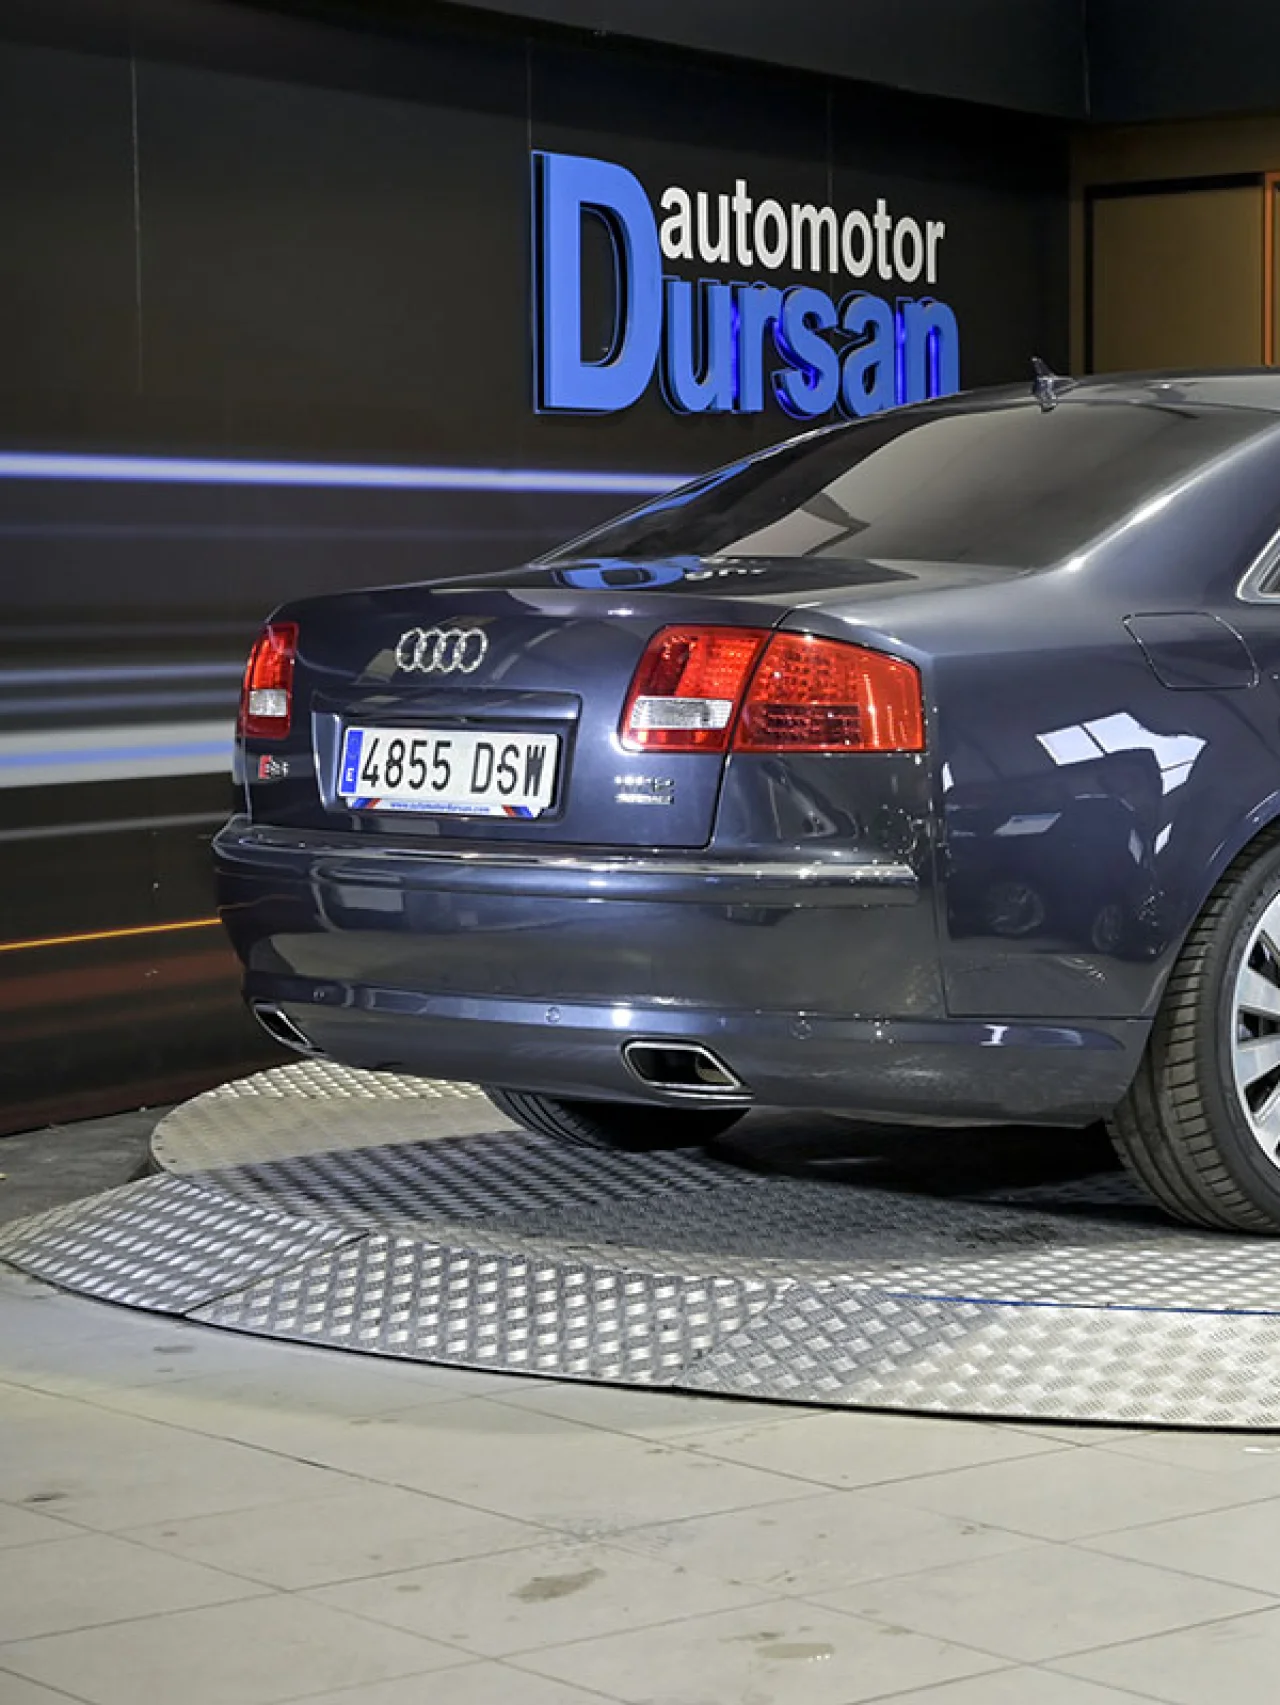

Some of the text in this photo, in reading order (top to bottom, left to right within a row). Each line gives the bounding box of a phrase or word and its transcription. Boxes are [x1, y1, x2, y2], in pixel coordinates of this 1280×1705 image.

[660, 179, 945, 284] automotor
[532, 149, 960, 421] Dursan
[361, 738, 546, 797] 4855 DSW
